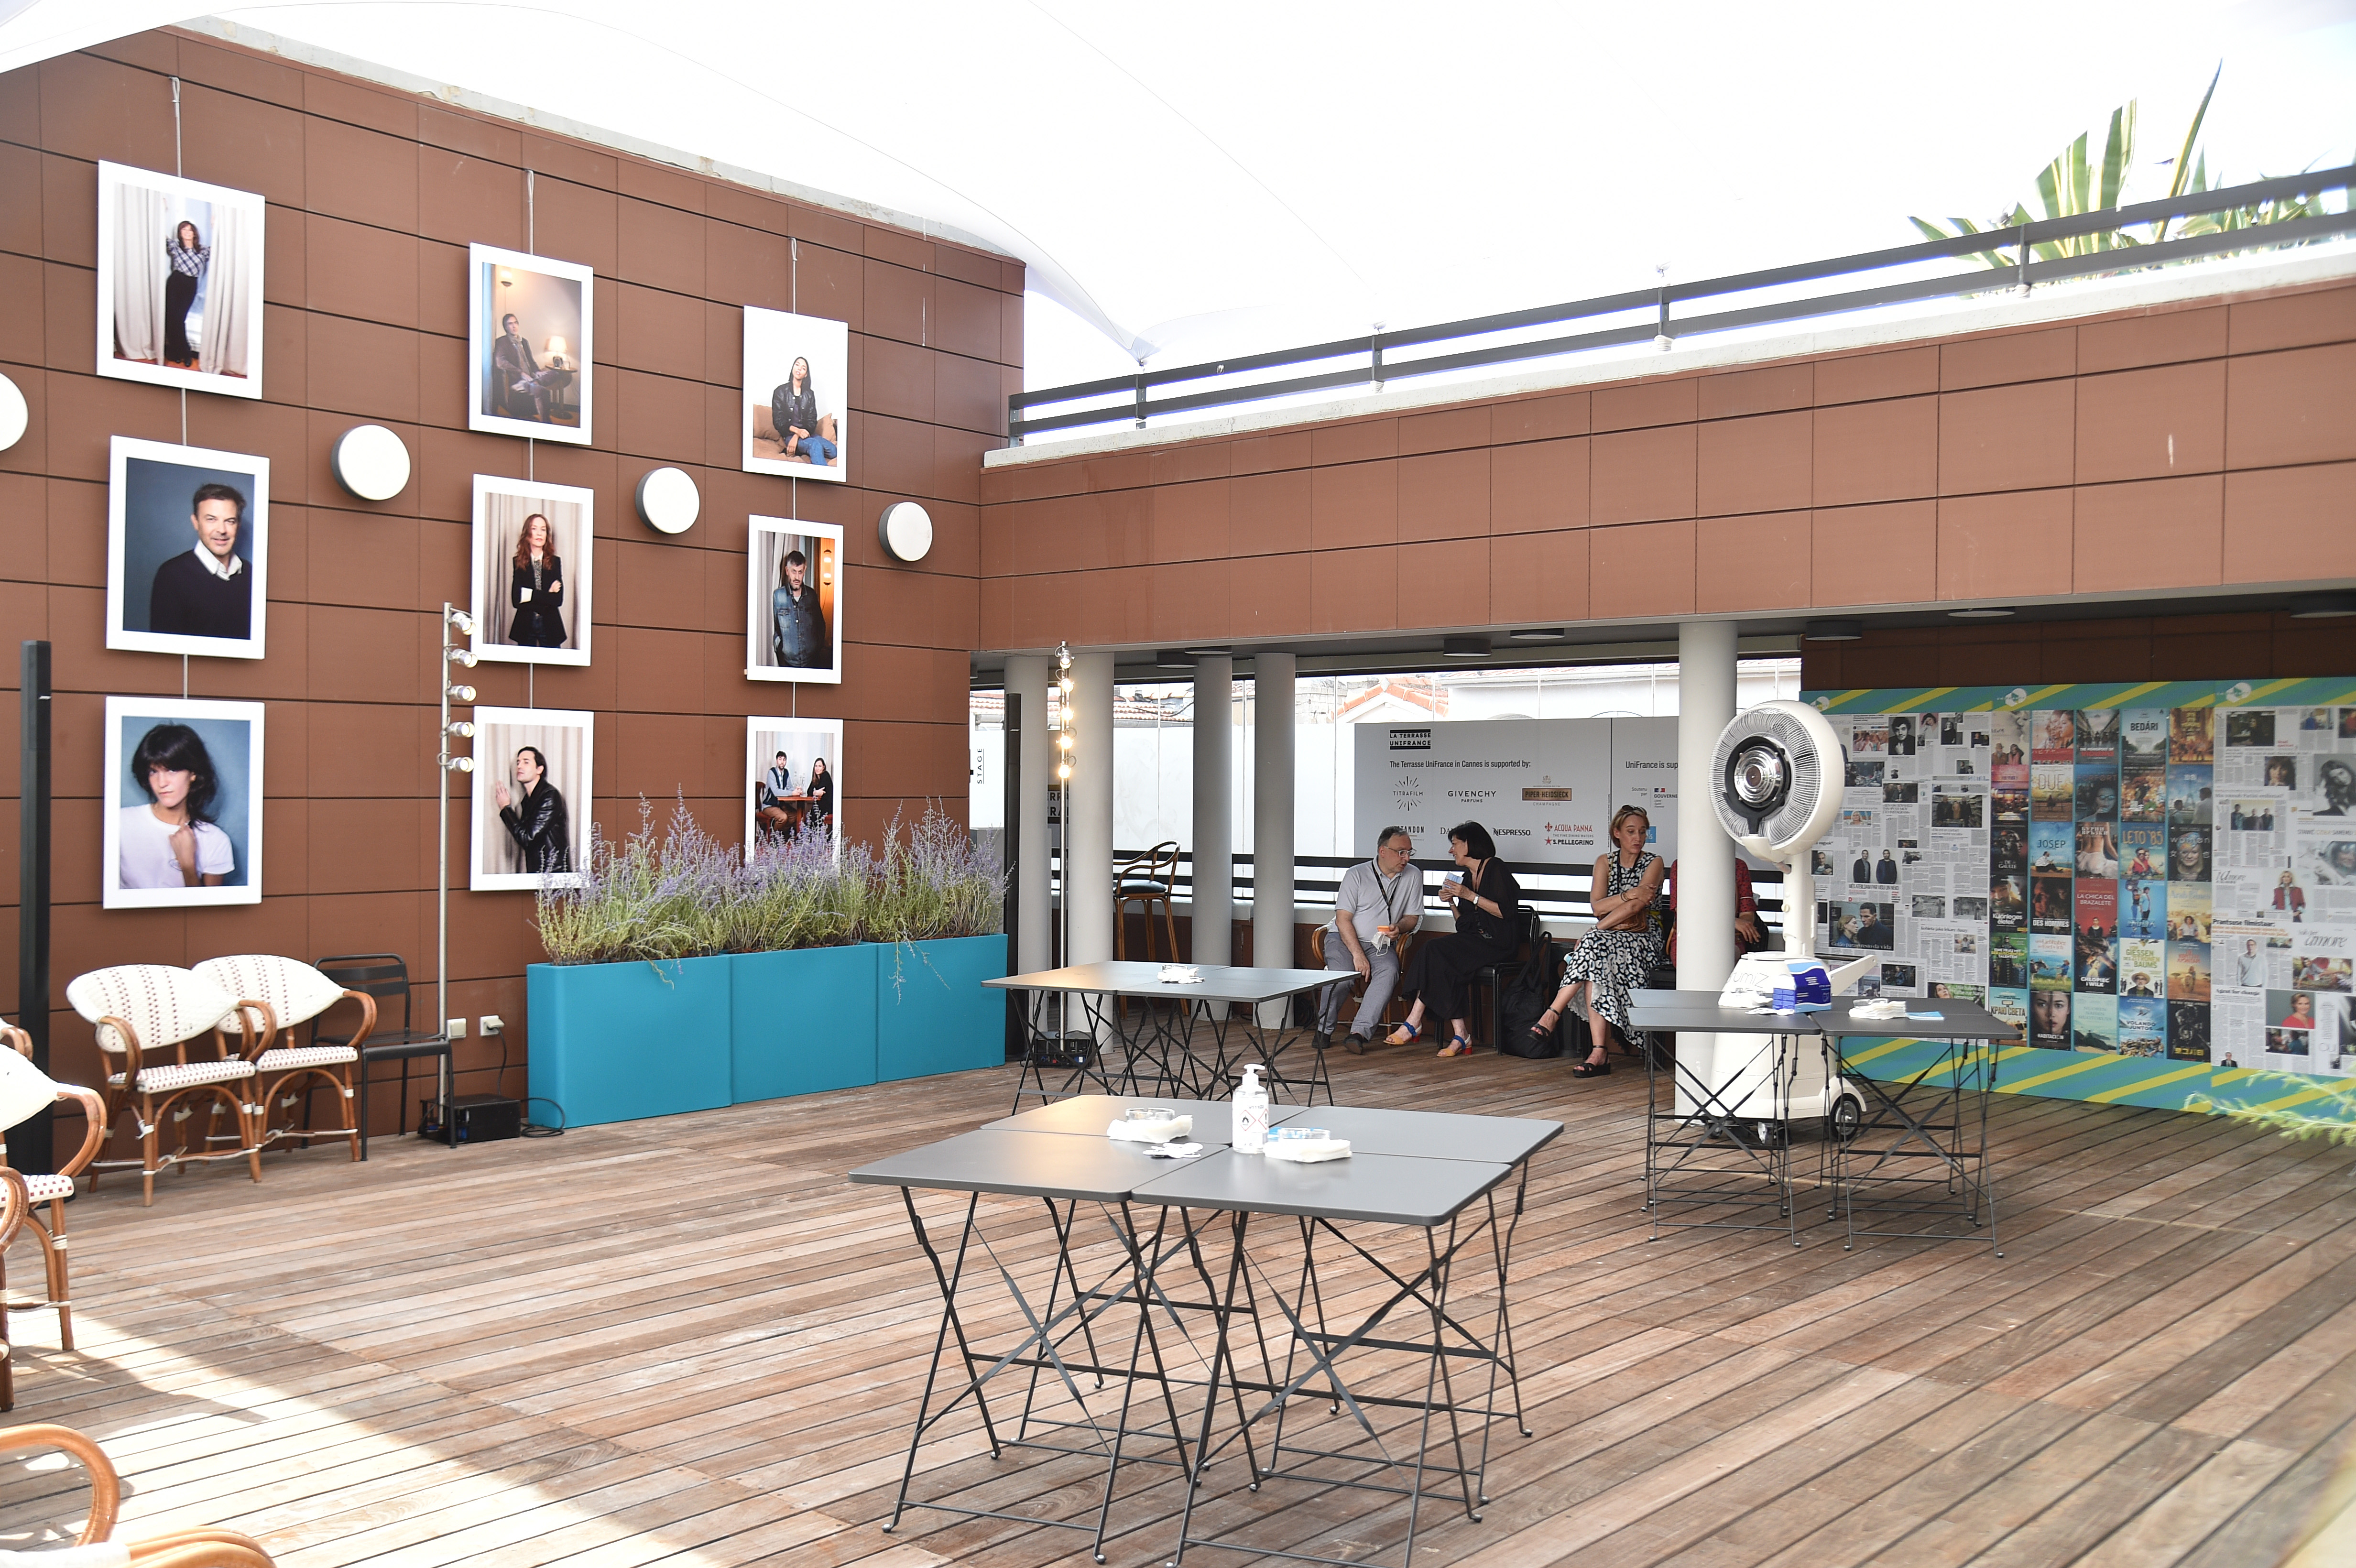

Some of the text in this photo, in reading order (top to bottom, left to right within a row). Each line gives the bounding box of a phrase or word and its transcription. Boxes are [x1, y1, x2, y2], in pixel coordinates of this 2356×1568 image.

[2130, 720, 2158, 731] BEDÁRI
[1491, 760, 1520, 768] supported
[1522, 760, 1531, 768] by:
[2039, 774, 2065, 789] DUE
[2123, 830, 2146, 845] LETO
[2037, 839, 2066, 848] JOSEP
[2007, 1007, 2026, 1016] СВЕТА
